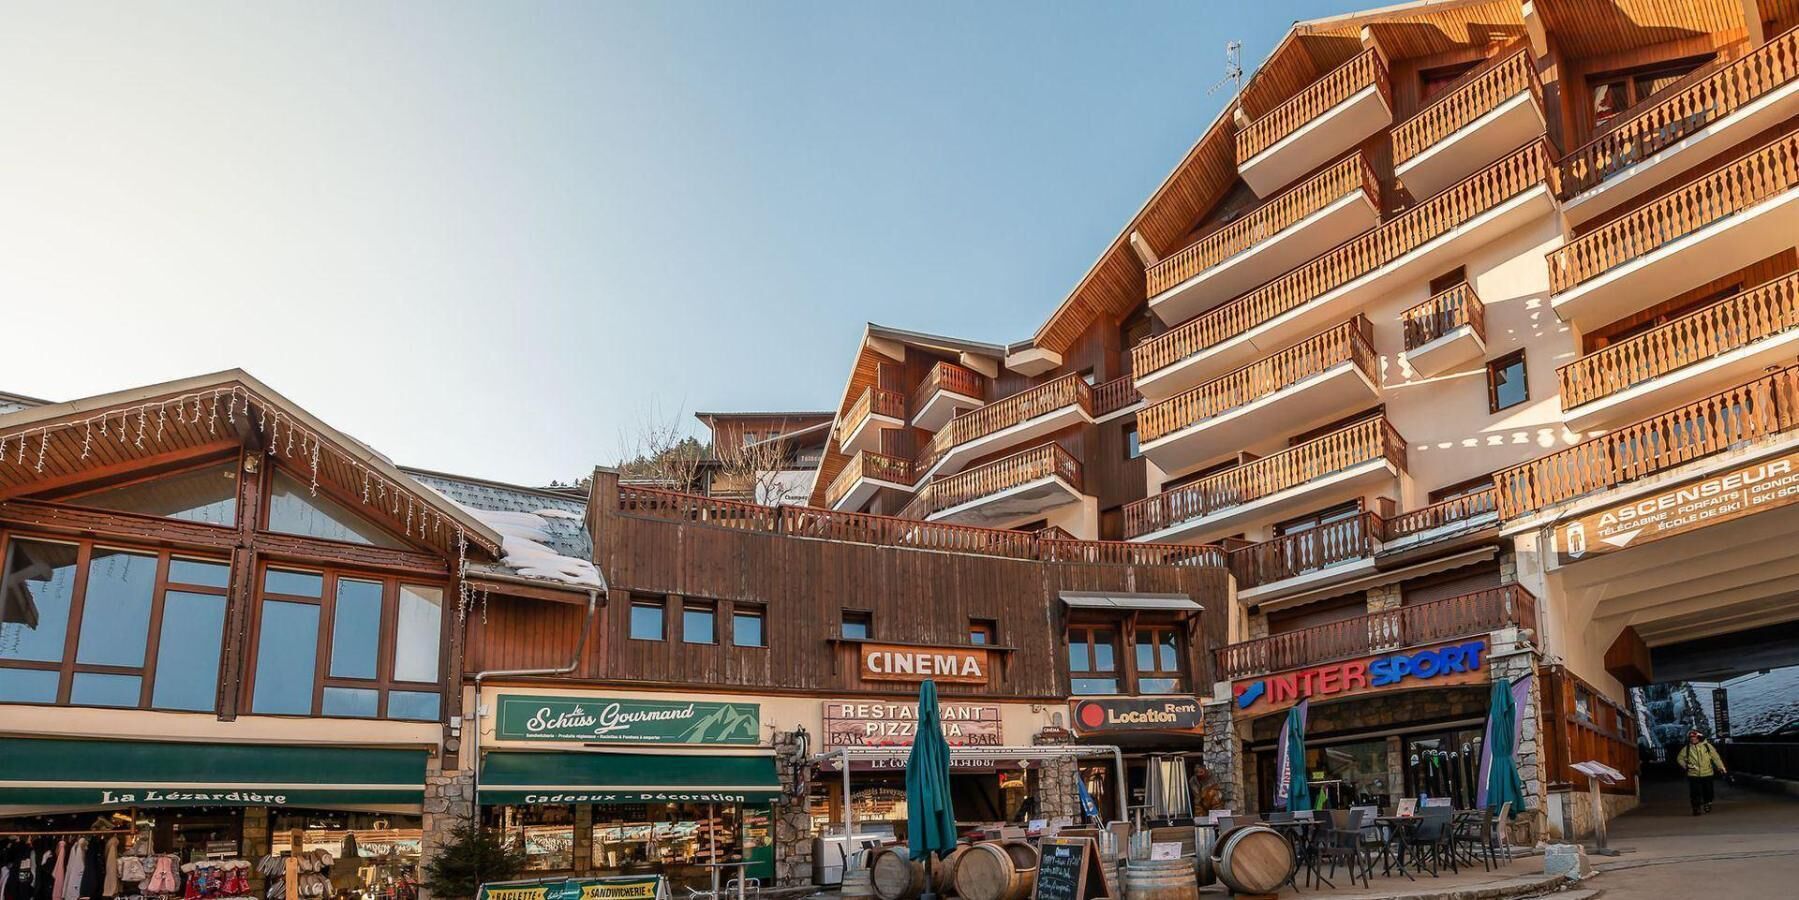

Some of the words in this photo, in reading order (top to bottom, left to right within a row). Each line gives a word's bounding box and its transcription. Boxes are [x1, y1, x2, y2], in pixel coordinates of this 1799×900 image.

[1598, 459, 1791, 528] ASCENSEUR
[1753, 492, 1775, 505] SKI
[1598, 512, 1668, 536] TÉLÉCABINE
[1678, 491, 1740, 514] FORFAITS
[1657, 514, 1698, 531] ÉCOLE
[1700, 511, 1716, 521] DE
[1716, 501, 1741, 516] SKI
[866, 651, 982, 677] CINEMA
[1265, 640, 1484, 704] INTERSPORT
[841, 704, 984, 721] RESTAANT
[1165, 703, 1196, 713] Rent
[526, 707, 596, 732] Schuss
[594, 702, 694, 734] Gourmand
[1108, 708, 1177, 724] Location
[865, 722, 963, 737] PIZZIA
[830, 732, 864, 745] BAR
[968, 733, 1000, 745] BAR
[871, 759, 887, 769] LE
[101, 790, 135, 805] La
[144, 791, 287, 804] Lézardière
[525, 793, 616, 804] Cadeaux
[640, 793, 745, 803] Décoration
[590, 886, 646, 898] SANDWICHERIE
